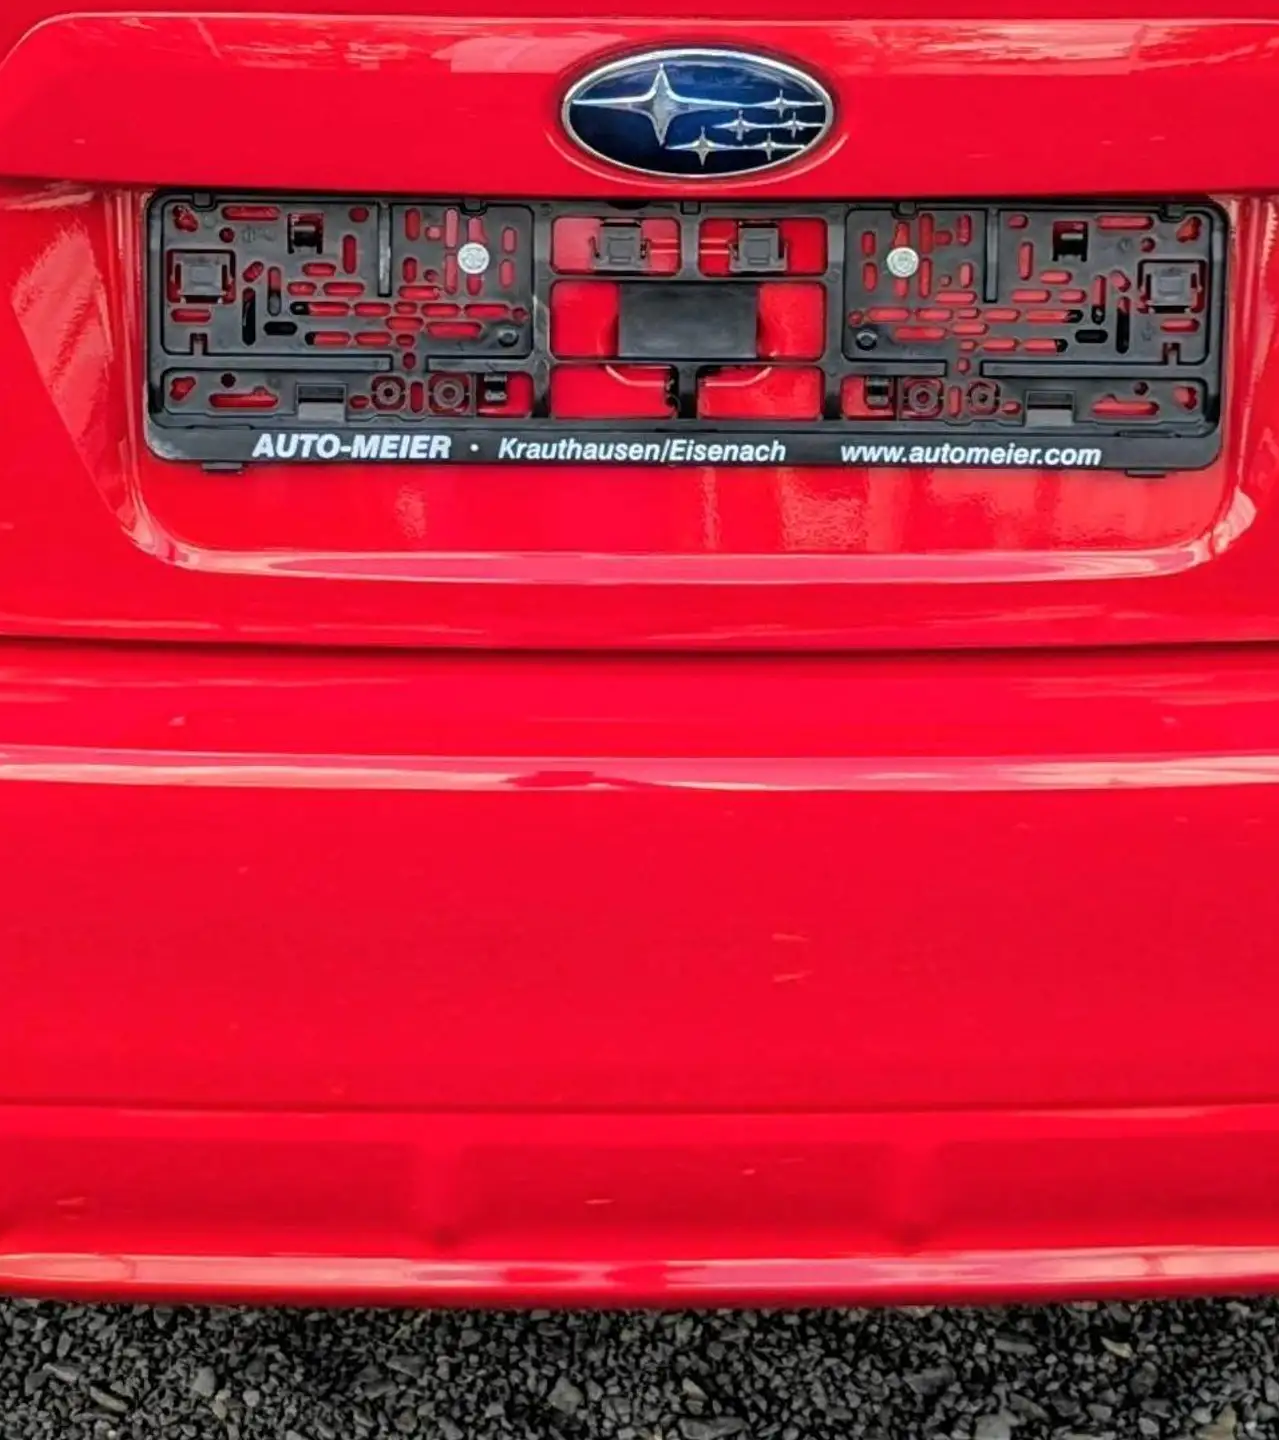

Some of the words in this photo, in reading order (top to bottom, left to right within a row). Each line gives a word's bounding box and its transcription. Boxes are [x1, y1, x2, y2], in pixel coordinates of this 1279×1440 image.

[251, 433, 452, 460] AUTO-MEIER
[498, 437, 787, 463] Krauthausen/Eisenach
[840, 442, 1102, 466] www.automeier.com
